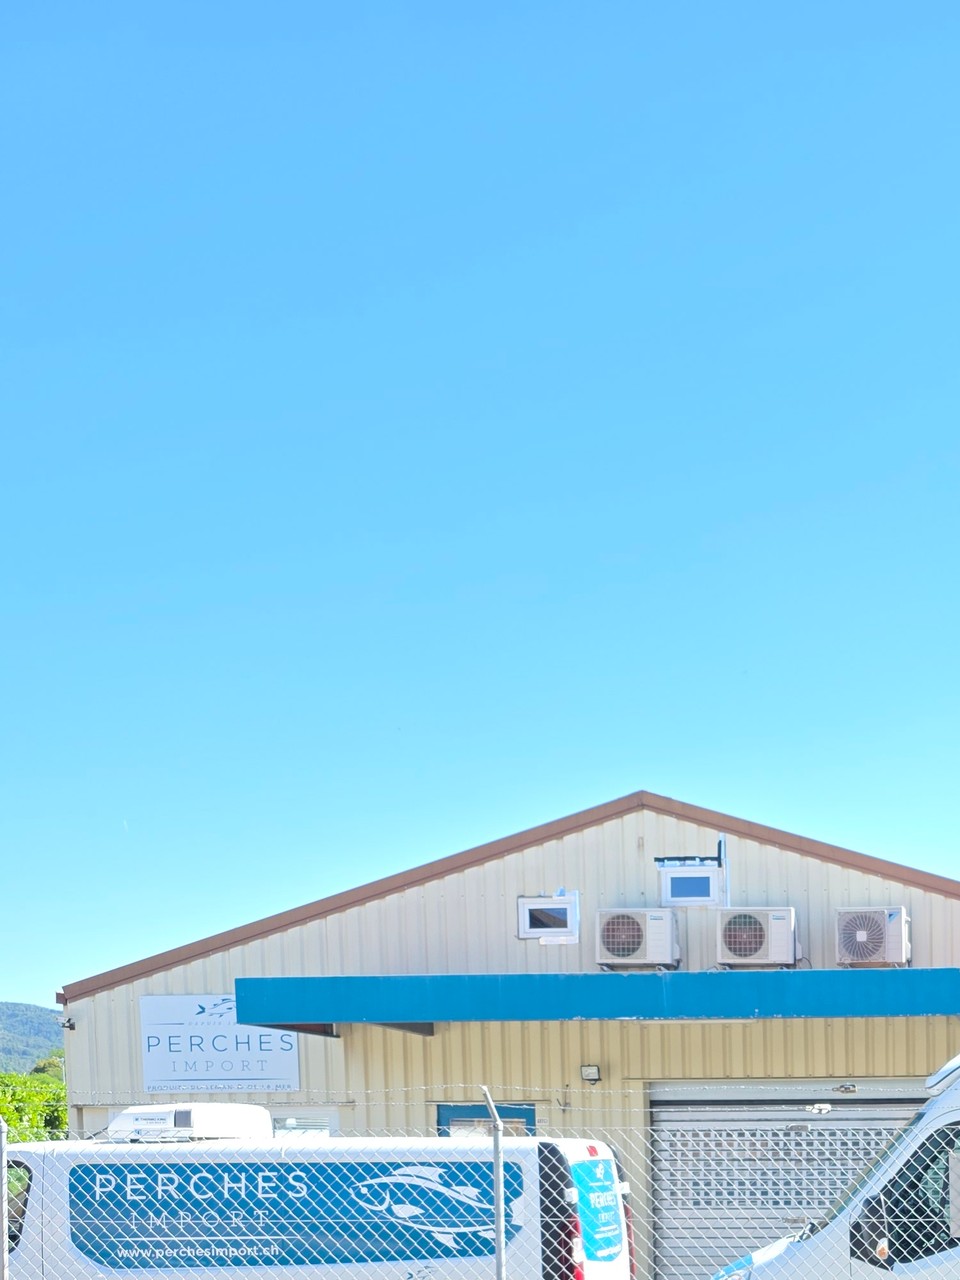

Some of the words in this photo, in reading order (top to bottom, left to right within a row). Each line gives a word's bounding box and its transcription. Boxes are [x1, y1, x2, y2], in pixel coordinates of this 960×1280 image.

[147, 1034, 293, 1052] PERCHES
[172, 1060, 268, 1071] IMPORT
[95, 1171, 308, 1200] PERCHES
[129, 1210, 269, 1229] IMPORT
[117, 1244, 279, 1258] www.perchesimport.ch
